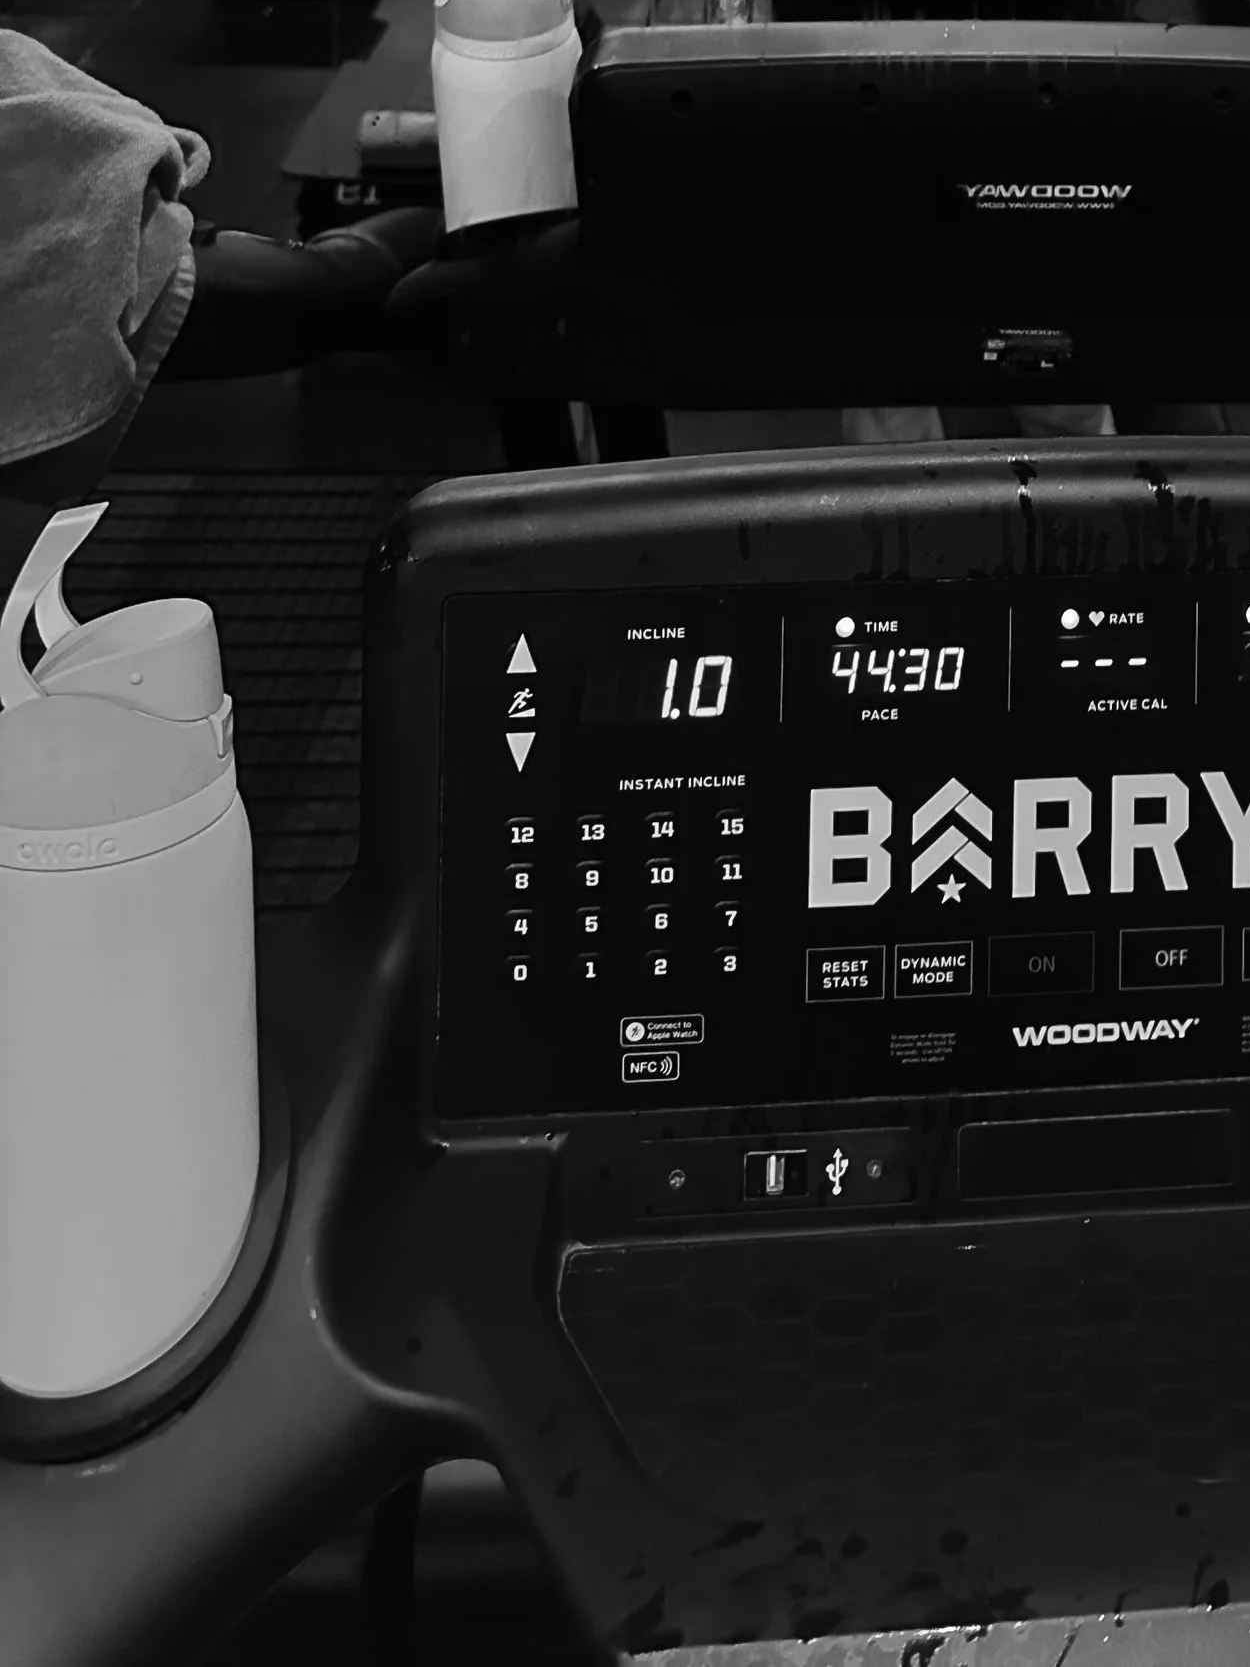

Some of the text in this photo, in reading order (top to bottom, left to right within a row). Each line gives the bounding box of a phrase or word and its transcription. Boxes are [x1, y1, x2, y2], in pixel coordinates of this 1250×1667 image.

[864, 621, 897, 632] TIME
[1110, 613, 1143, 624] RATE
[628, 628, 685, 639] INCLINE
[662, 656, 732, 719] 1.0
[1088, 699, 1167, 711] ACTIVE CAL
[862, 709, 898, 720] PACE
[620, 775, 745, 790] INSTANT INCLINE
[582, 824, 604, 840] 13
[652, 821, 674, 838] 14
[721, 818, 743, 835] 15
[512, 827, 534, 843] 12
[17, 836, 120, 865] owala
[586, 870, 599, 886] 9
[651, 868, 673, 883] 10
[723, 864, 742, 880] 11
[515, 873, 528, 889] 8
[585, 916, 598, 932] 5
[655, 913, 668, 929] 6
[726, 911, 737, 926] 7
[514, 919, 528, 935] 4
[724, 956, 736, 971] 3
[901, 955, 965, 969] DYNAMIC
[1029, 956, 1055, 972] ON
[1156, 950, 1187, 966] OFF
[514, 965, 527, 981] 0
[586, 962, 596, 978] 1
[655, 959, 667, 975] 2
[823, 960, 868, 973] RESET
[823, 976, 868, 988] STATS
[913, 971, 953, 984] MODE
[647, 1022, 681, 1030] Connect
[1012, 1018, 1193, 1047] WOODWAY
[647, 1030, 698, 1040] Apple Watch
[630, 1061, 657, 1074] NFC
